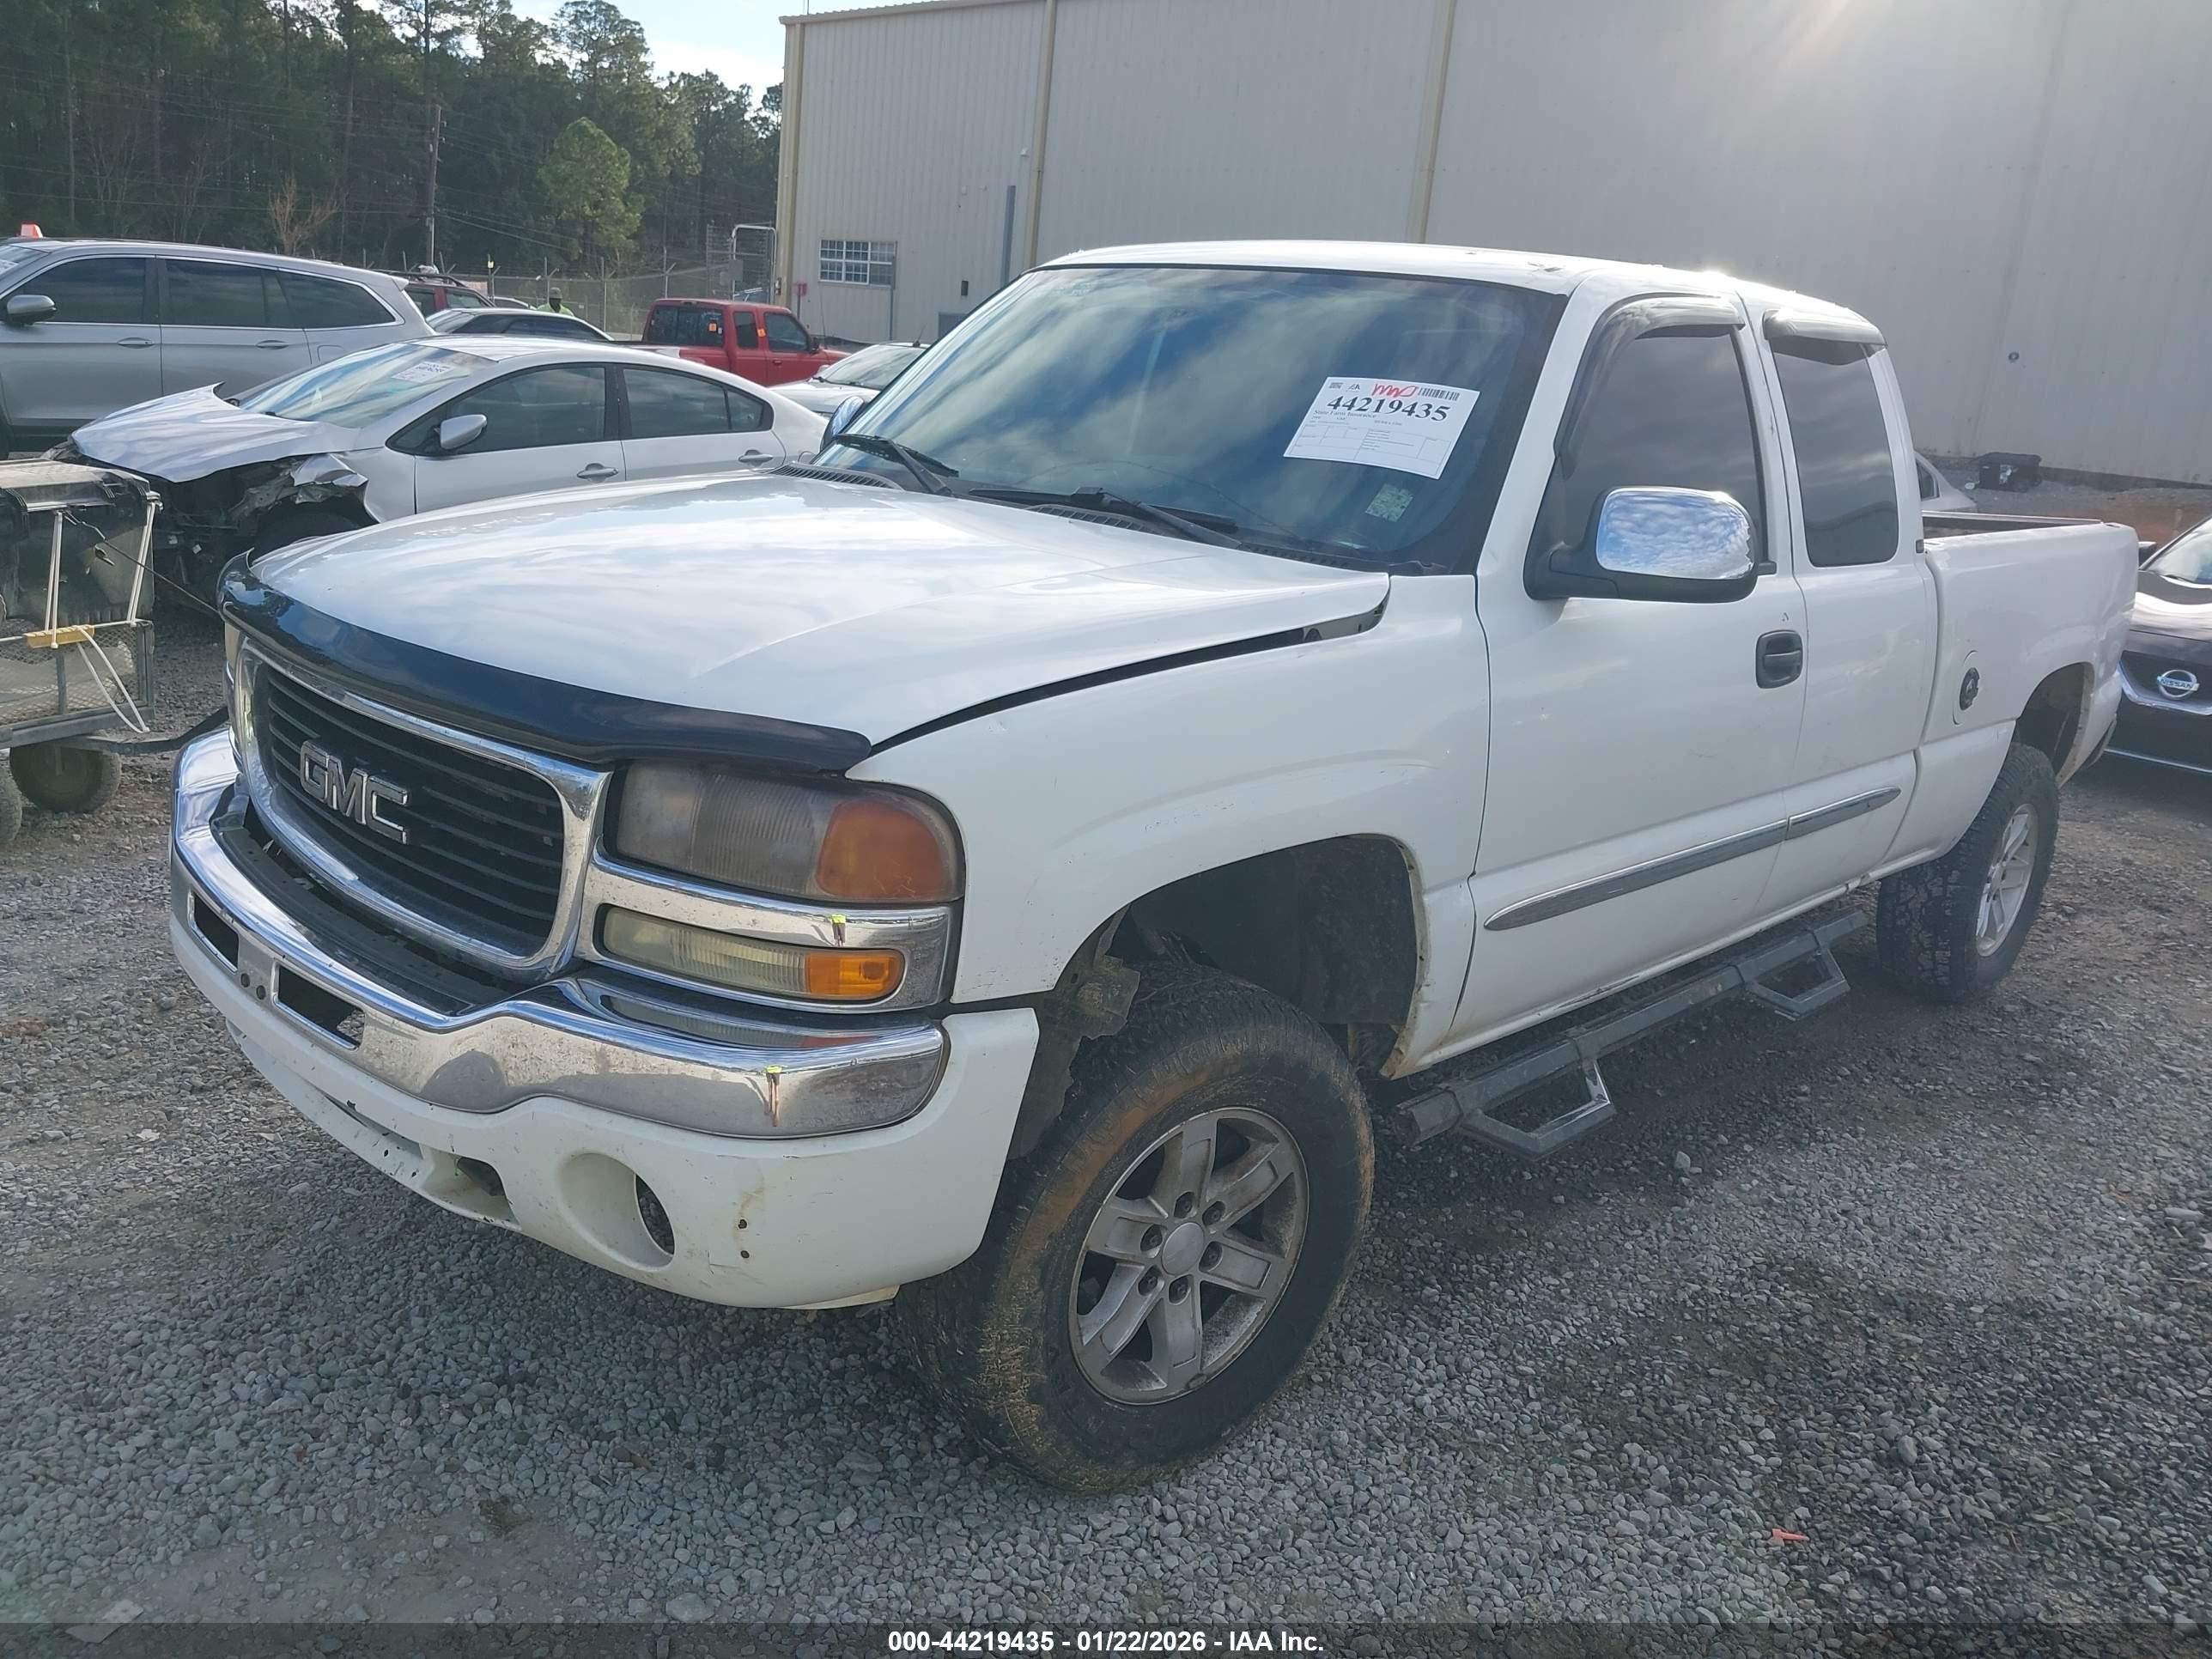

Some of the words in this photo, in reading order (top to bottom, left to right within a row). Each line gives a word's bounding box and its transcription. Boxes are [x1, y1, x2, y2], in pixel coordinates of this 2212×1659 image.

[1327, 396, 1450, 421] 44219435
[2160, 678, 2195, 689] NISSAN
[301, 740, 408, 844] GMC
